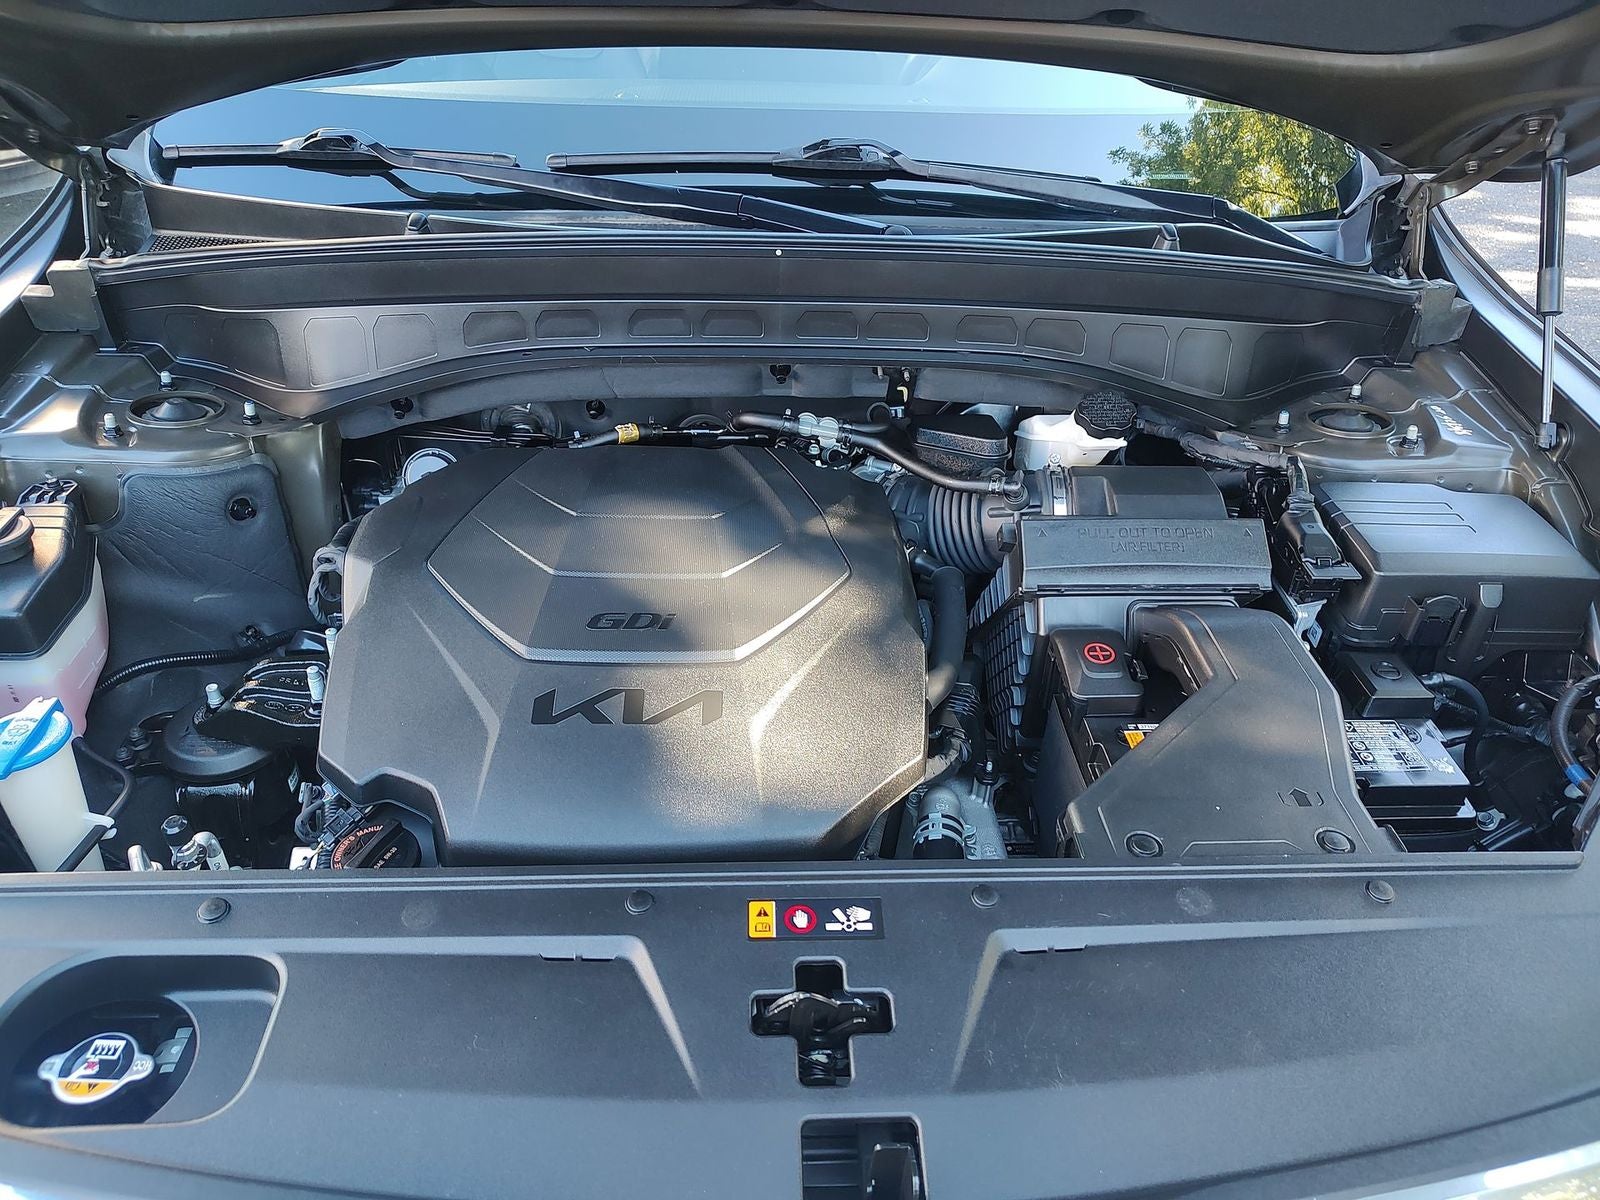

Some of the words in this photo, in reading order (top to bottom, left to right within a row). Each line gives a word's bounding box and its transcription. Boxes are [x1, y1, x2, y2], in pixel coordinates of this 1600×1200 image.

[1078, 527, 1115, 539] PULL
[1118, 527, 1146, 539] OUT
[1153, 527, 1171, 539] TO
[1174, 527, 1215, 540] OPEN
[585, 612, 677, 631] GDi
[531, 687, 724, 726] KIA
[357, 825, 383, 836] MANU
